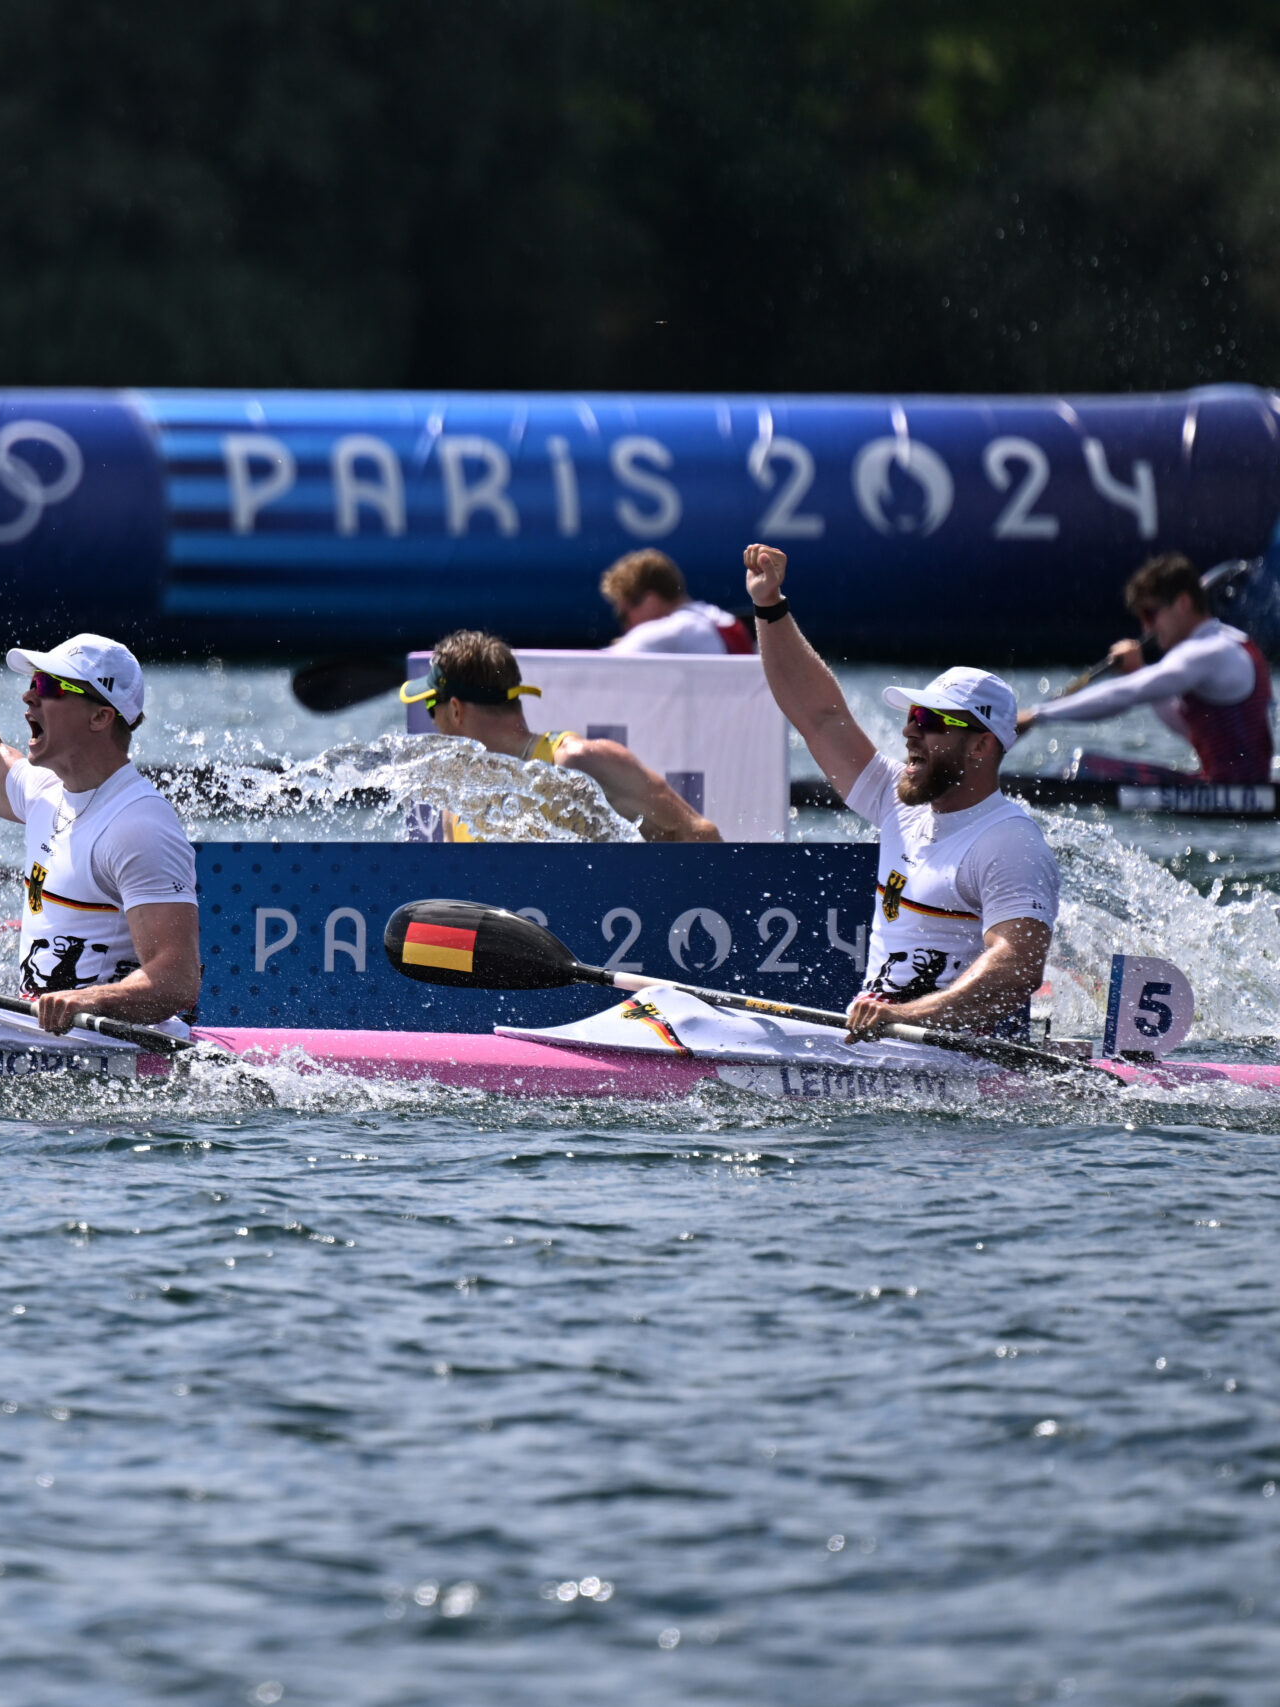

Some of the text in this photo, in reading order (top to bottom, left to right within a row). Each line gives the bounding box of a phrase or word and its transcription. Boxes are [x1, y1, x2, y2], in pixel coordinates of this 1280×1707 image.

[223, 433, 1160, 539] PARIS 2024
[601, 907, 866, 972] 2024
[1134, 981, 1173, 1038] 5
